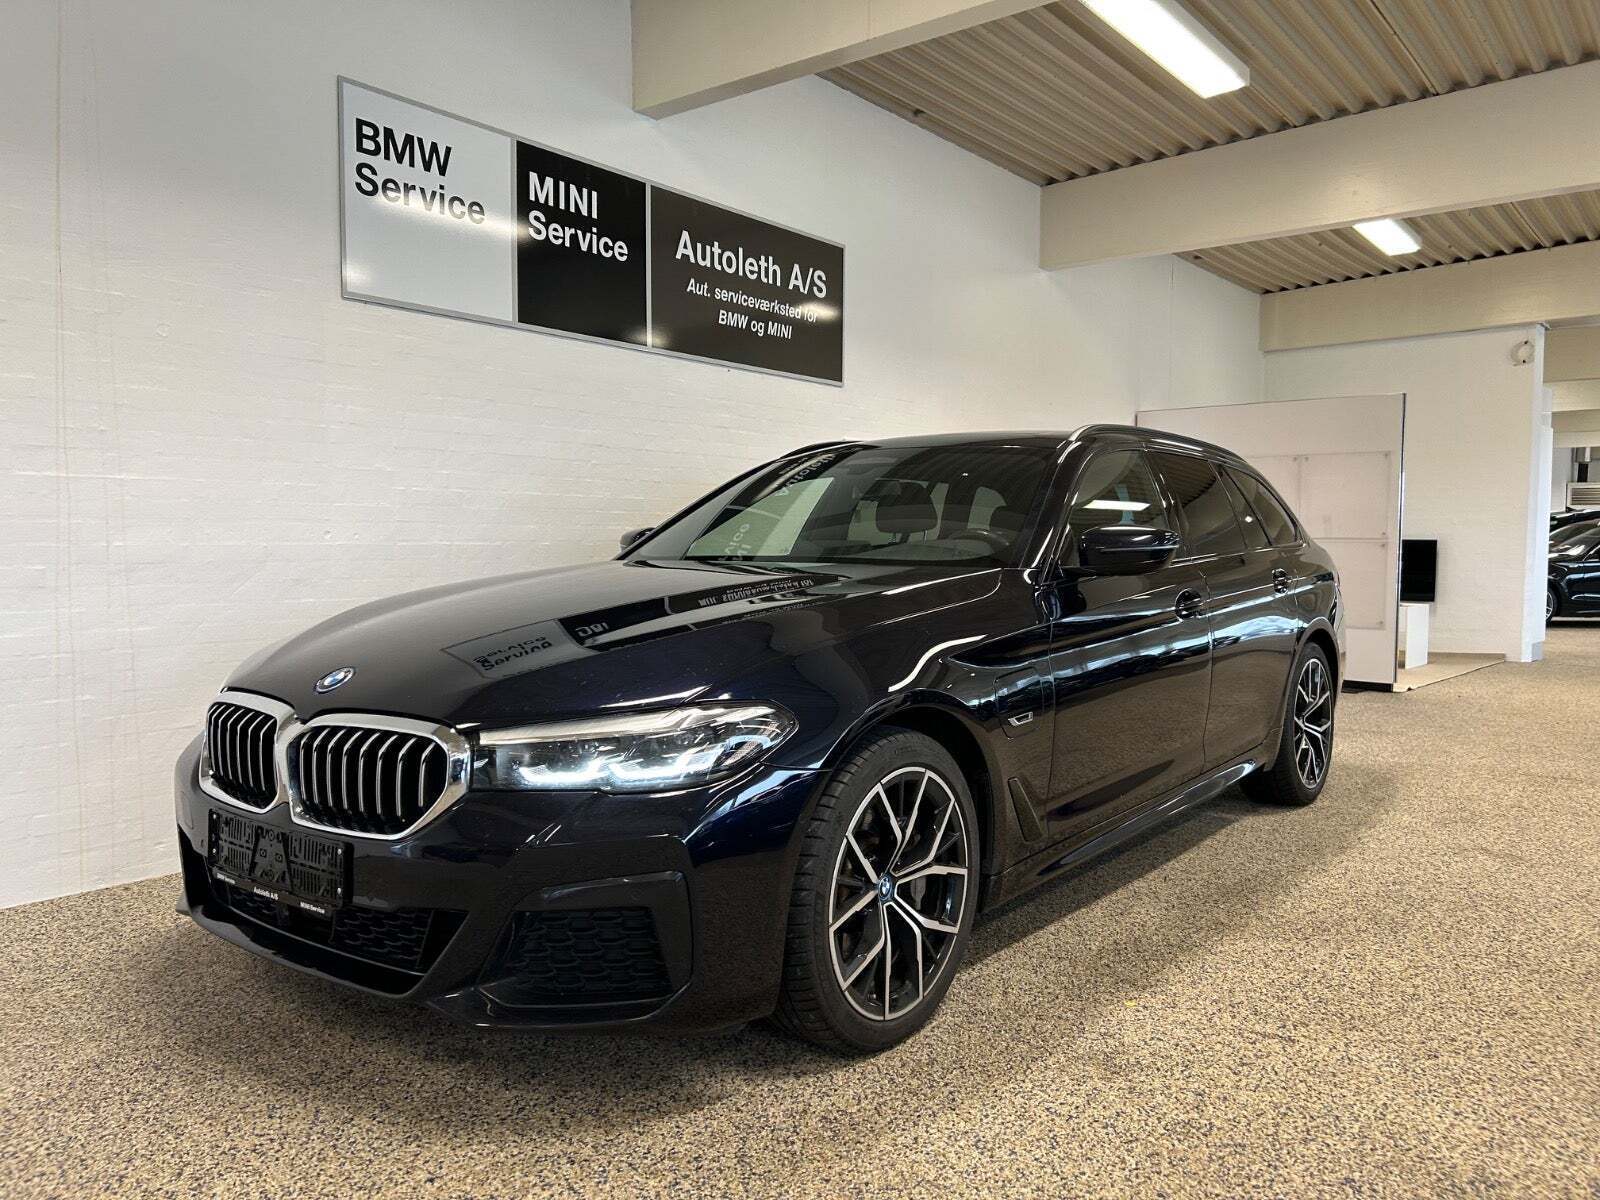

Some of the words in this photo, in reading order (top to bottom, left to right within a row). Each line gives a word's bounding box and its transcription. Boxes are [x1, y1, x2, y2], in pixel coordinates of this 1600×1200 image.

[356, 117, 452, 176] BMW
[355, 162, 485, 224] Service
[528, 171, 598, 219] MINI
[528, 210, 629, 262] Service
[675, 229, 781, 287] Autoleth
[788, 263, 827, 298] A/S
[686, 277, 711, 297] Aut.
[714, 286, 802, 320] serviceværksted
[804, 306, 818, 323] for
[718, 309, 749, 330] BMW
[750, 319, 764, 336] og
[767, 320, 793, 340] MINI
